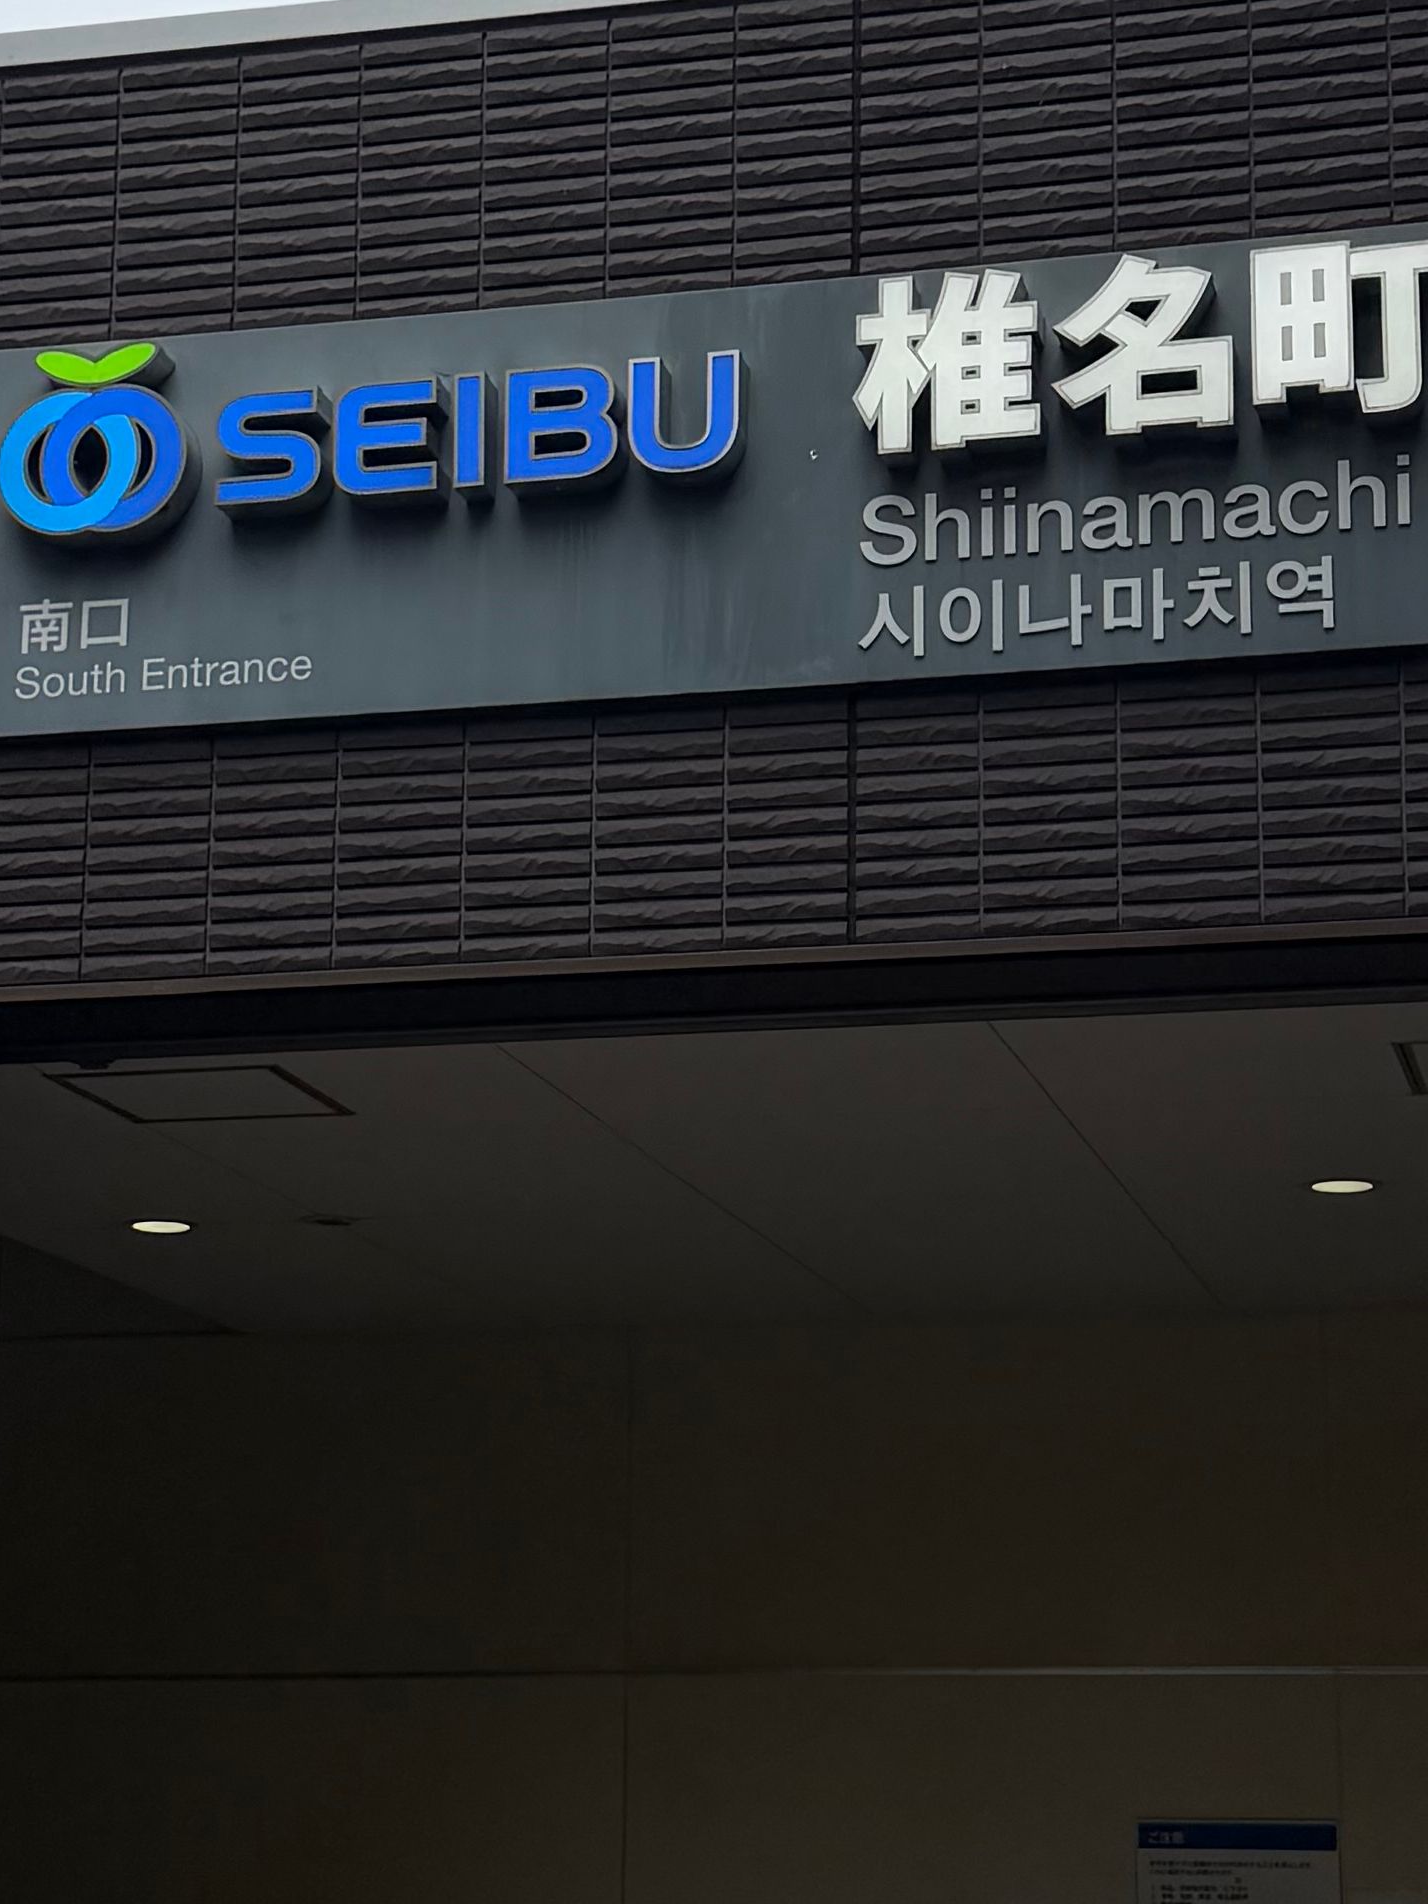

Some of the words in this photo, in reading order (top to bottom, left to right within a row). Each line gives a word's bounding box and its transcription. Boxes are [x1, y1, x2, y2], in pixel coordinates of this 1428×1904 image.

[214, 348, 742, 508] SEIBU
[858, 452, 1412, 567] Shiinamachi
[19, 597, 130, 655] 南口
[857, 554, 1337, 659] 시이나마치역
[14, 660, 126, 700] South
[141, 654, 313, 692] Entrance
